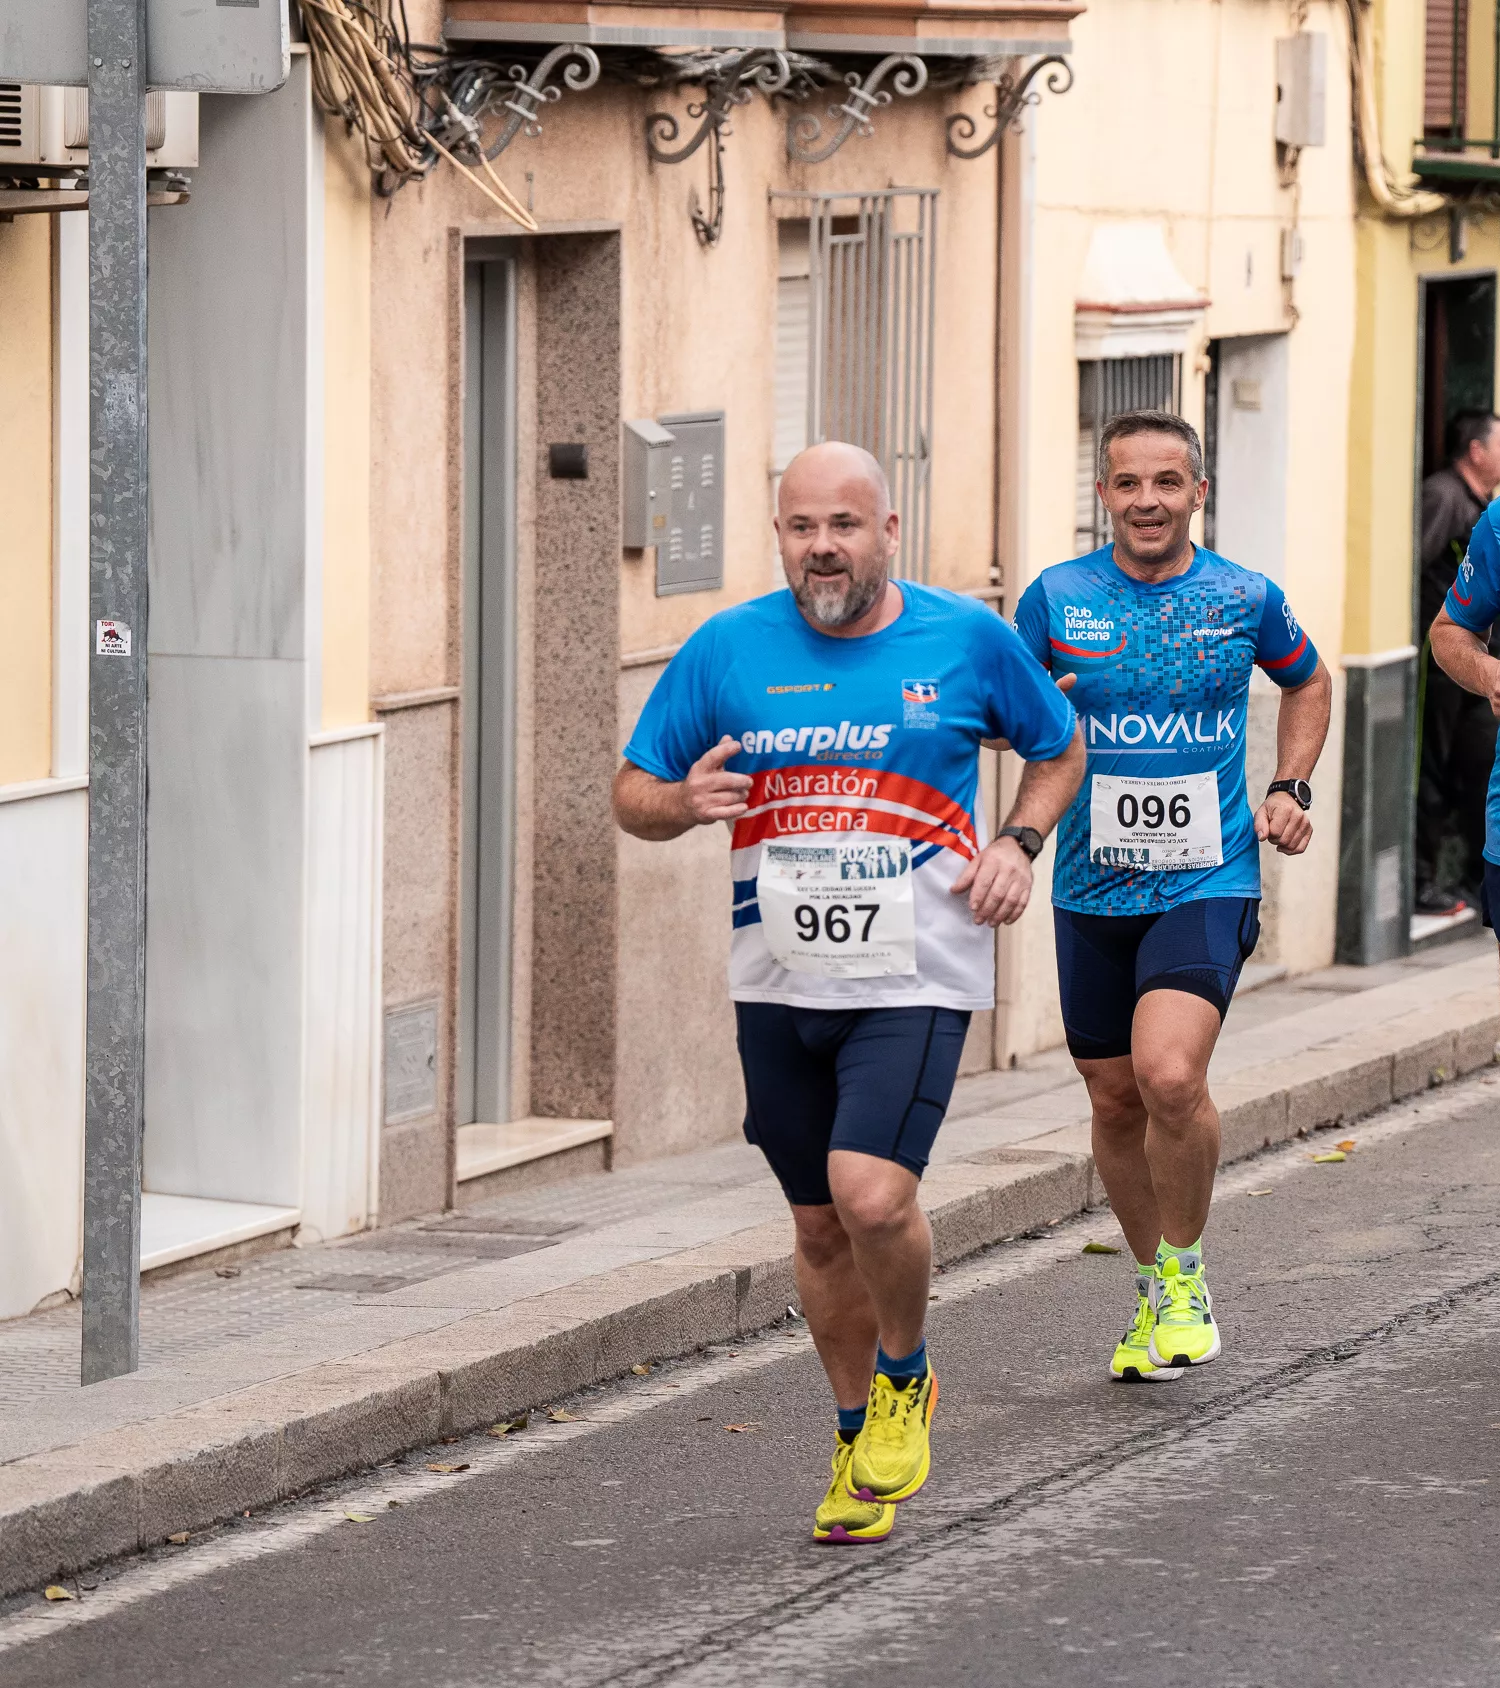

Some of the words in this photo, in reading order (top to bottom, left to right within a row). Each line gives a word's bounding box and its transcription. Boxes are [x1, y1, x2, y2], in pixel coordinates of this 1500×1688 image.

[1064, 605, 1092, 618] Club
[1065, 618, 1114, 630] Maratón
[1066, 629, 1110, 641] Lucena
[1193, 628, 1232, 637] enerplus
[767, 684, 821, 694] GSPORT
[741, 721, 894, 756] enerplus
[816, 750, 883, 760] directo
[764, 770, 878, 799] Maratón
[773, 810, 869, 832] Lucena
[837, 846, 878, 862] 2024
[1188, 861, 1219, 869] CARRERAS
[794, 904, 880, 943] 967
